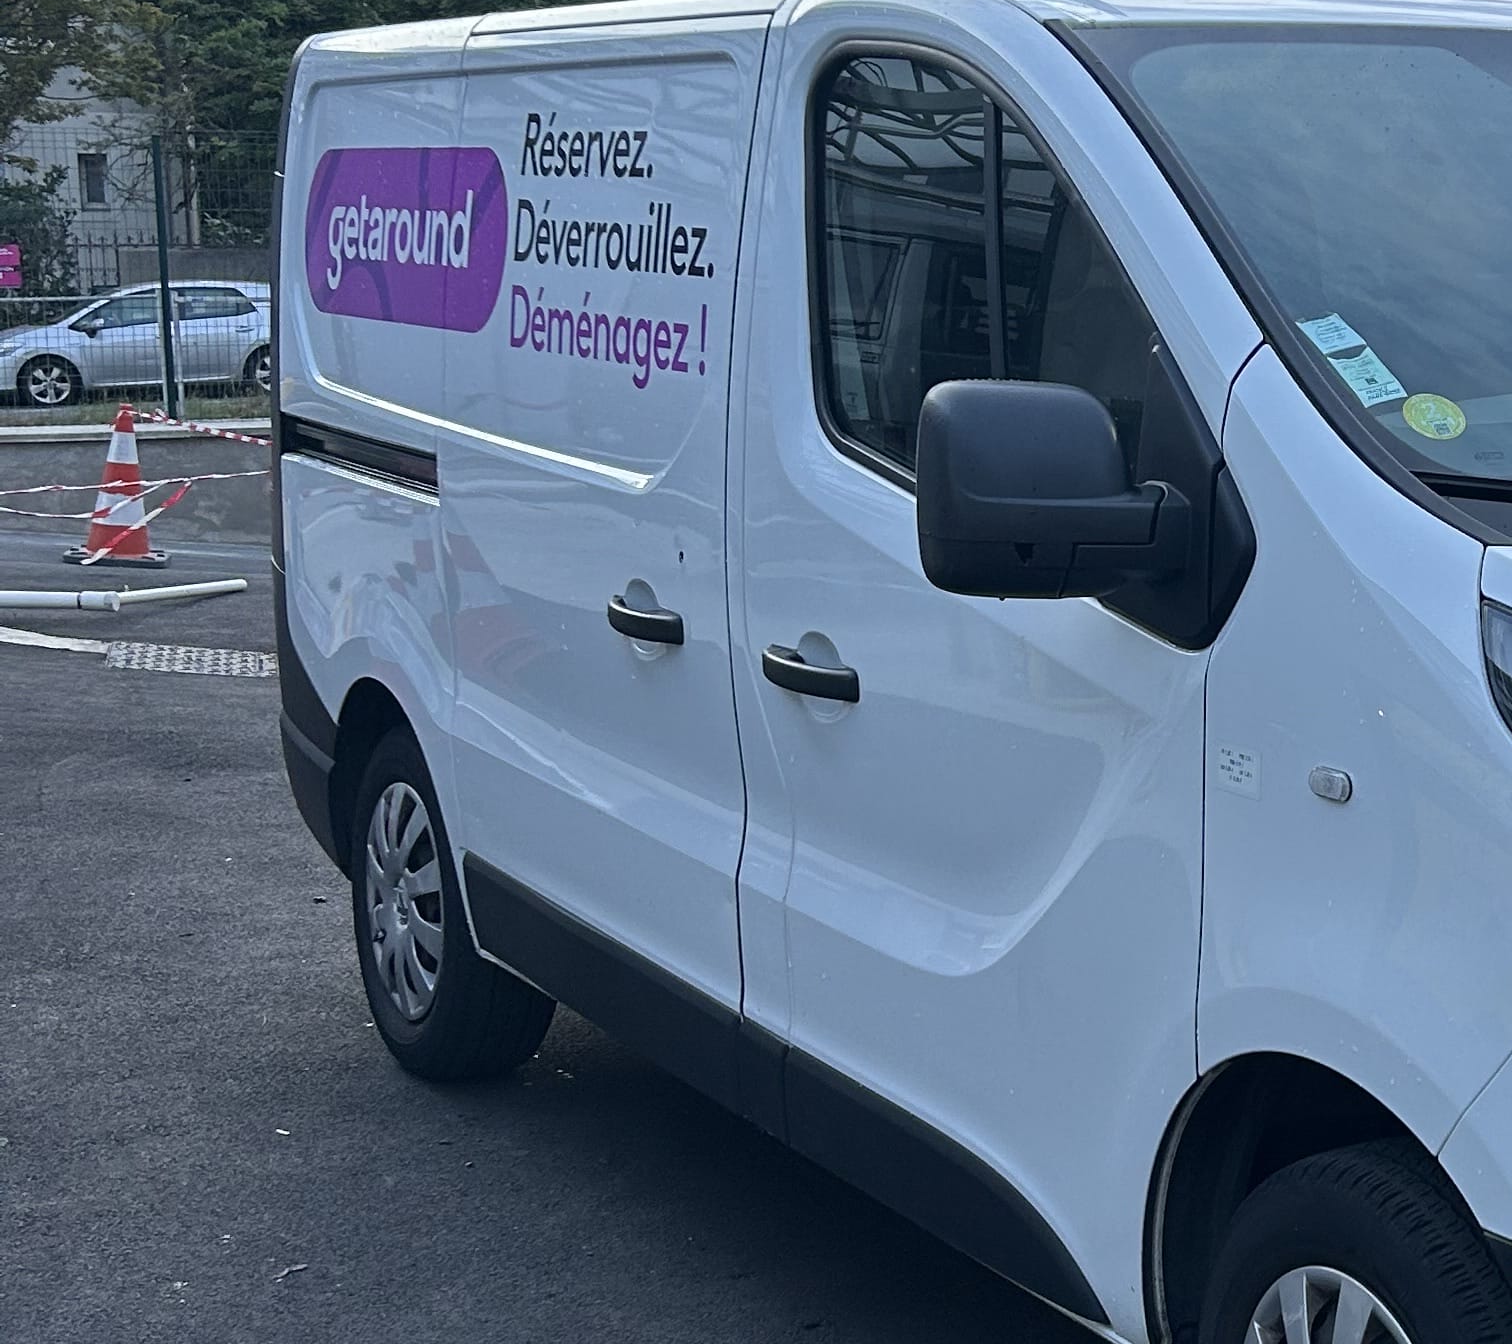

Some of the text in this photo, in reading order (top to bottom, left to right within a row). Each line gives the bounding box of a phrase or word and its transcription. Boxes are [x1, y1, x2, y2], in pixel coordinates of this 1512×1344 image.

[520, 112, 654, 179] Réservez.
[326, 189, 475, 290] getaround
[513, 198, 716, 279] Déverrouillez.
